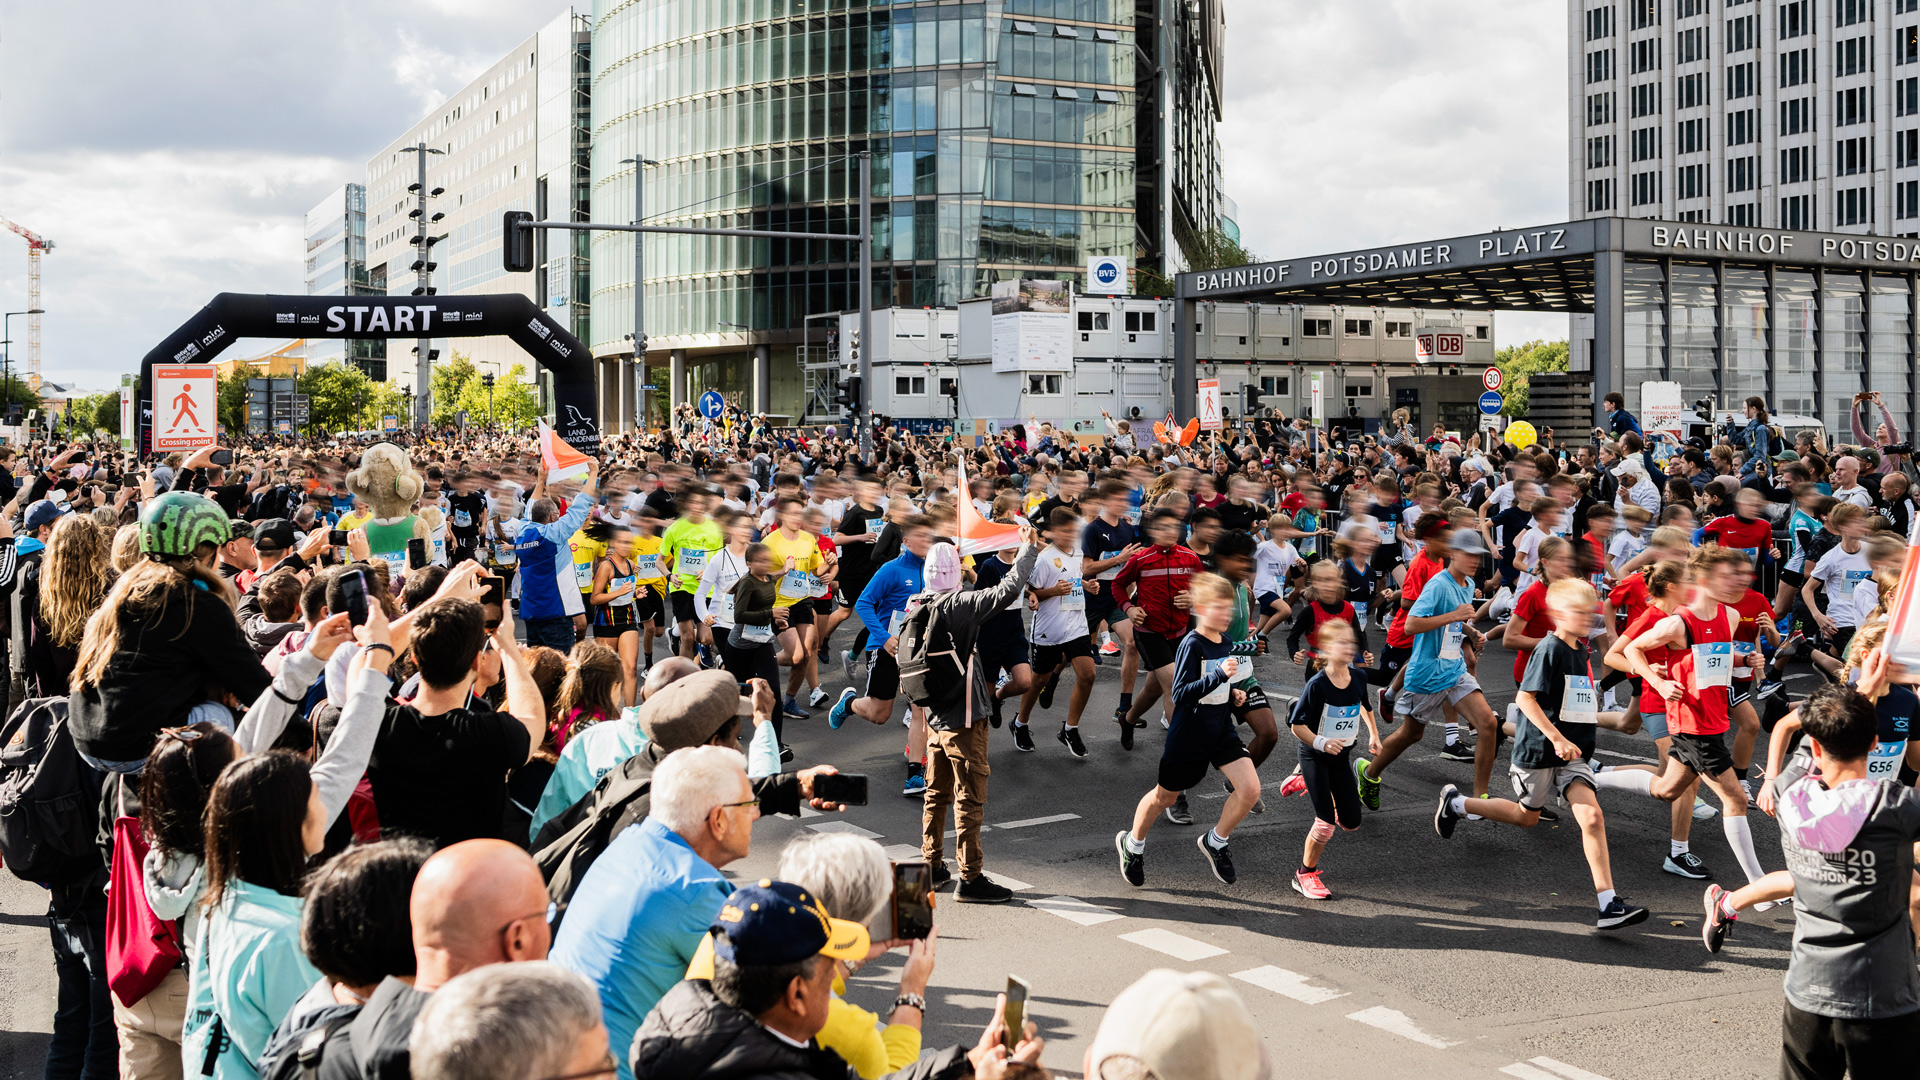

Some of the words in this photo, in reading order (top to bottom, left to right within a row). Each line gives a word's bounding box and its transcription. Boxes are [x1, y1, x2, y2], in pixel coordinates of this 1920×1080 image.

[1652, 226, 1794, 254] BAHNHOF
[1196, 264, 1291, 292] BAHNHOF
[1310, 244, 1451, 279] POTSDAMER
[1479, 228, 1567, 258] PLATZ
[1098, 269, 1116, 277] BVE
[326, 305, 437, 333] START
[465, 311, 483, 319] mini
[202, 325, 224, 344] mini
[552, 340, 572, 356] mini
[1420, 338, 1432, 352] DB
[1440, 337, 1460, 352] DB
[1487, 373, 1499, 385] 30
[160, 438, 190, 446] Crossing
[192, 438, 210, 446] point
[686, 557, 700, 565] 2272
[1576, 692, 1592, 703] 1116
[1336, 720, 1354, 731] 674
[1868, 760, 1894, 773] 656
[1784, 851, 1820, 869] BERLIN
[1847, 848, 1876, 867] 20
[1847, 868, 1877, 885] 23
